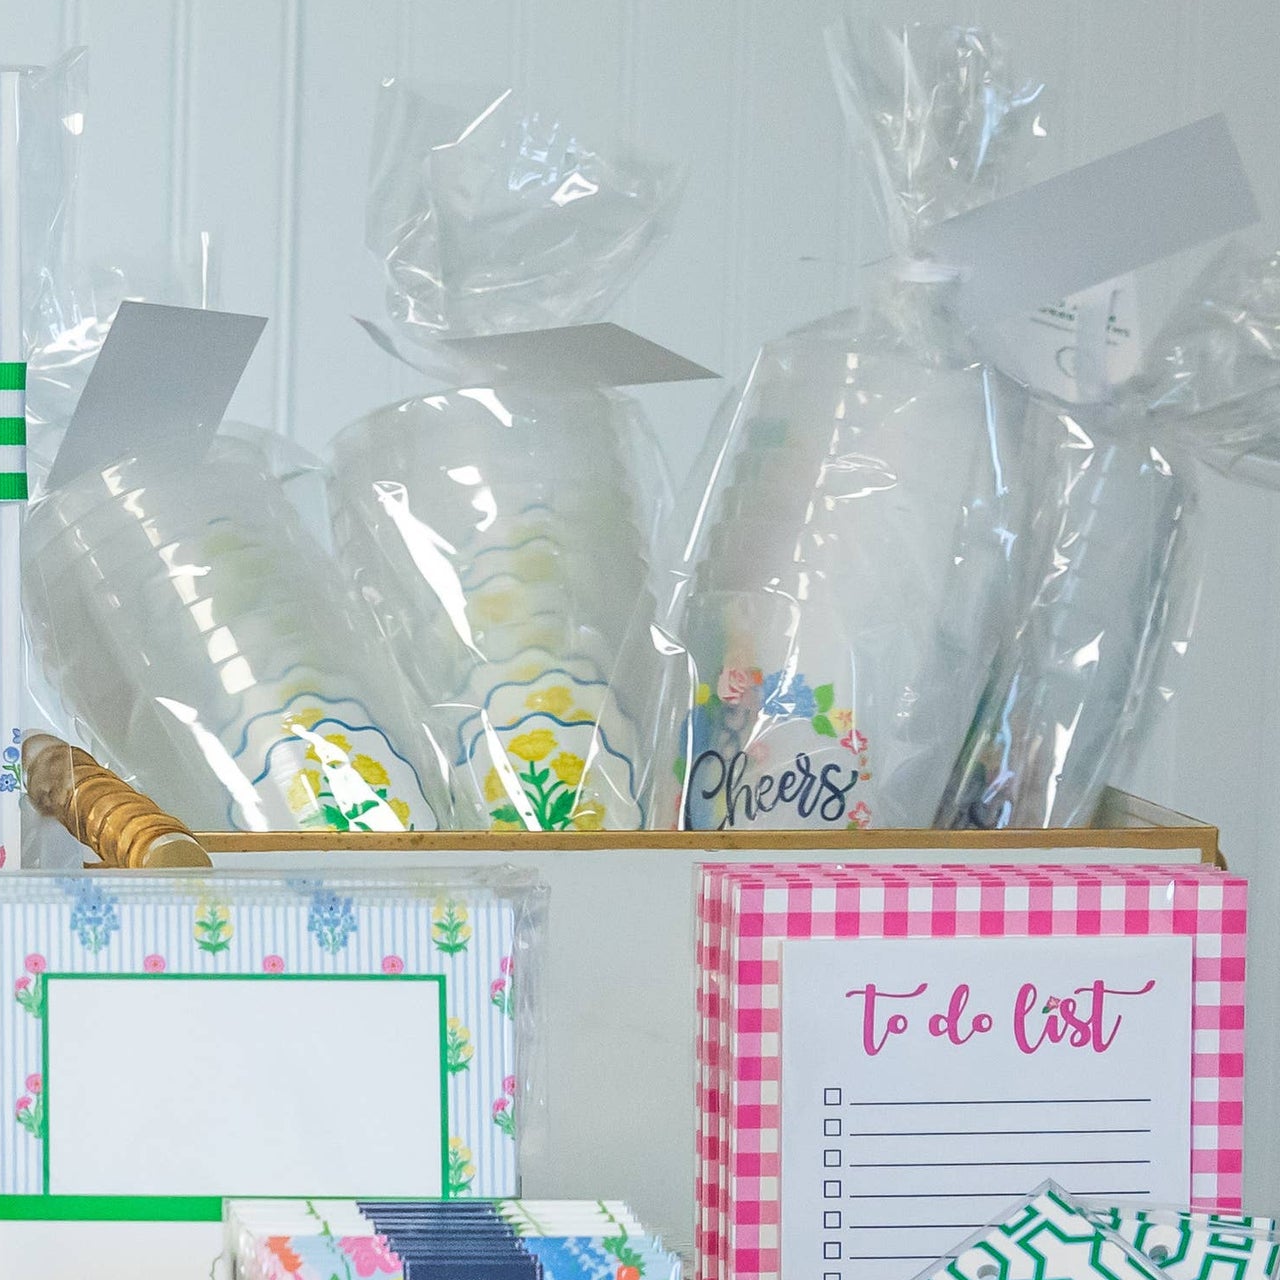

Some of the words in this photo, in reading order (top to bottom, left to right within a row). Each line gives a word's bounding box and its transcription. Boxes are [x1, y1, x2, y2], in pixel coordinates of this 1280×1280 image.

[684, 750, 858, 831] Cheers
[845, 982, 928, 1056] to
[928, 983, 992, 1045] do
[1013, 979, 1156, 1054] list
